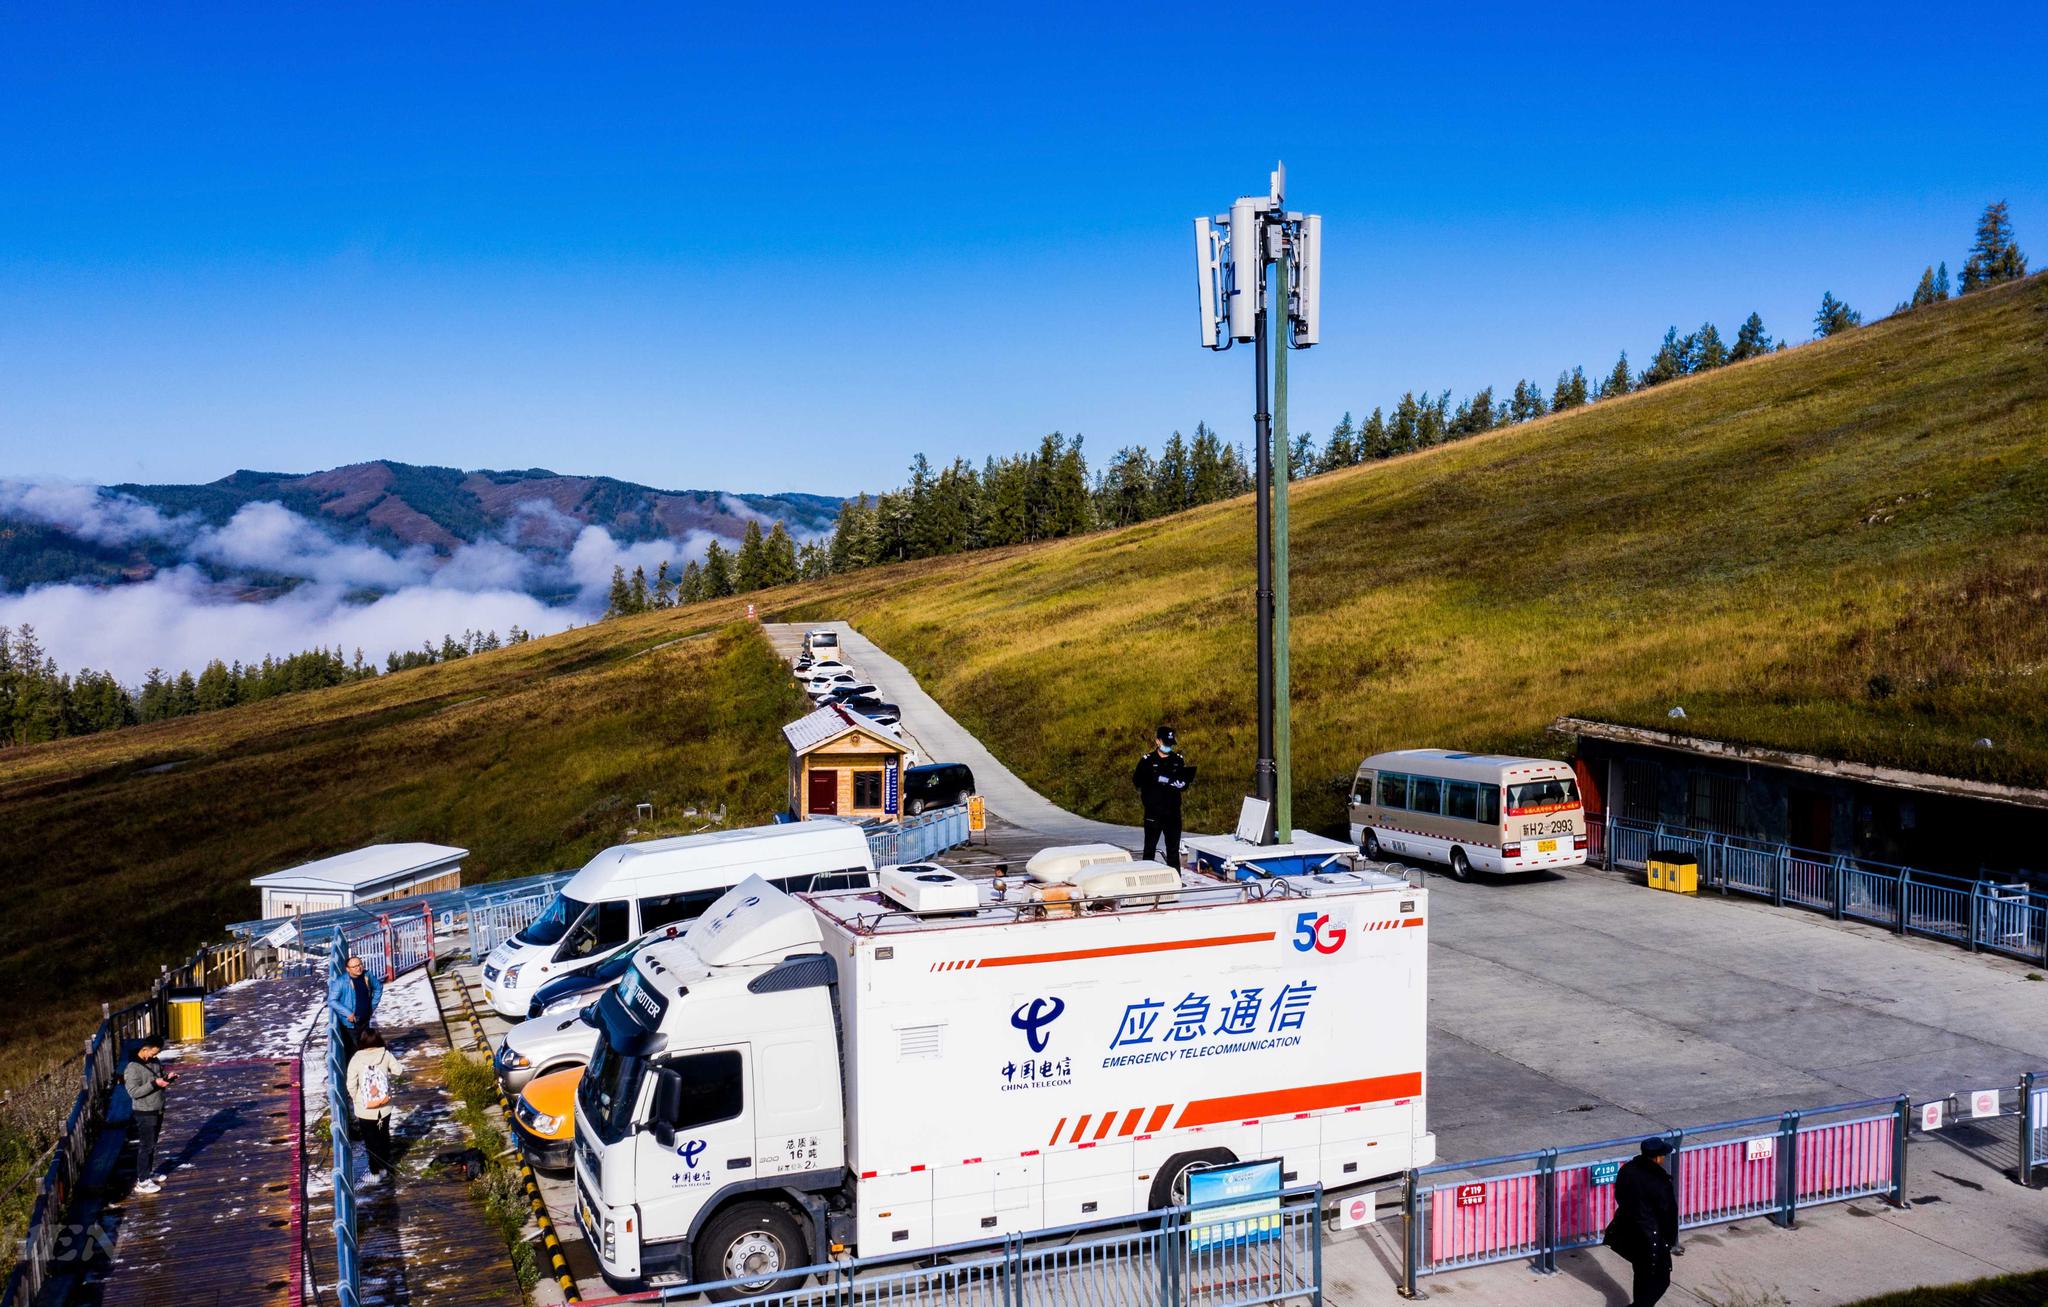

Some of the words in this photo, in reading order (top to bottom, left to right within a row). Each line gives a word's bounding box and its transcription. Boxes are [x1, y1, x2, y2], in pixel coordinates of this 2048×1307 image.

[1551, 819, 1573, 833] 2993
[1293, 912, 1346, 954] 5G
[1109, 980, 1317, 1050] 应急通信
[1102, 1050, 1176, 1068] EMERGENCY
[1179, 1036, 1301, 1060] TELECOMMUNICATION
[1001, 1057, 1071, 1083] 中国电信
[1001, 1083, 1029, 1091] CHINA
[1032, 1079, 1072, 1089] TELECOM
[671, 1170, 711, 1183] 中国电信
[1470, 1186, 1482, 1195] 119
